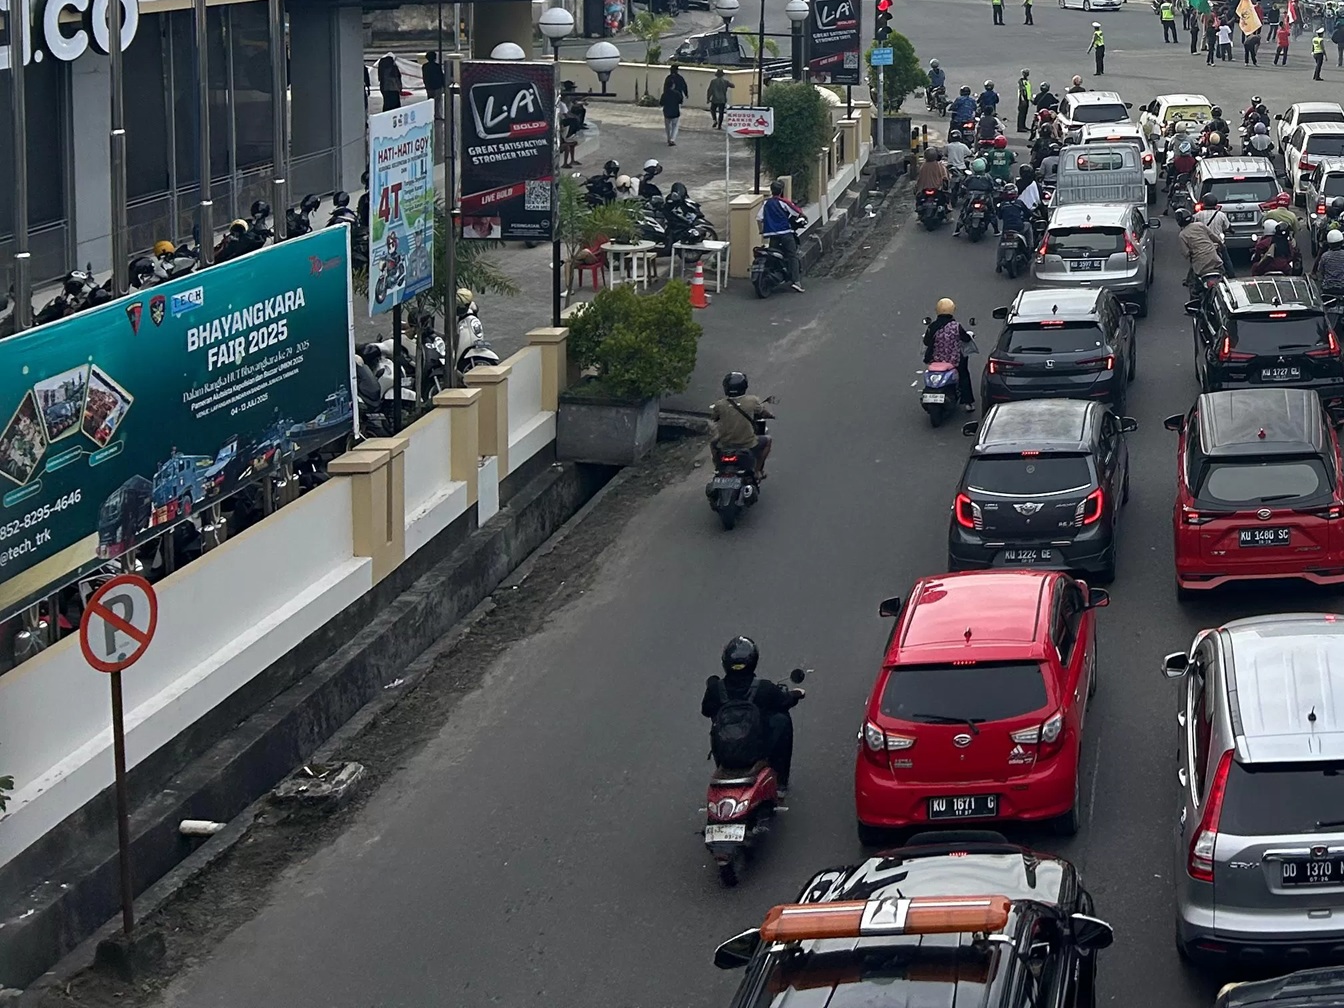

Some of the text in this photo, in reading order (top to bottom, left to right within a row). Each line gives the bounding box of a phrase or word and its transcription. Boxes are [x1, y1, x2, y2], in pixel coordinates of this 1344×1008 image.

[378, 140, 413, 164] HATI-HATI
[468, 144, 498, 156] GREAT
[472, 148, 538, 165] STRONGER TASTE
[378, 182, 402, 223] 4T
[481, 193, 495, 205] LIVE
[187, 287, 305, 352] BHAYANGKARA
[207, 319, 288, 372] FAIR 2025
[1272, 368, 1288, 376] 1727
[1240, 529, 1289, 541] KU 1480 SC
[0, 528, 52, 566] @tech_trk
[1005, 551, 1015, 560] KU
[1017, 550, 1037, 559] 1224
[933, 798, 946, 812] KU
[953, 797, 975, 811] 1671
[1283, 862, 1297, 877] DD
[1306, 861, 1332, 876] 1370
